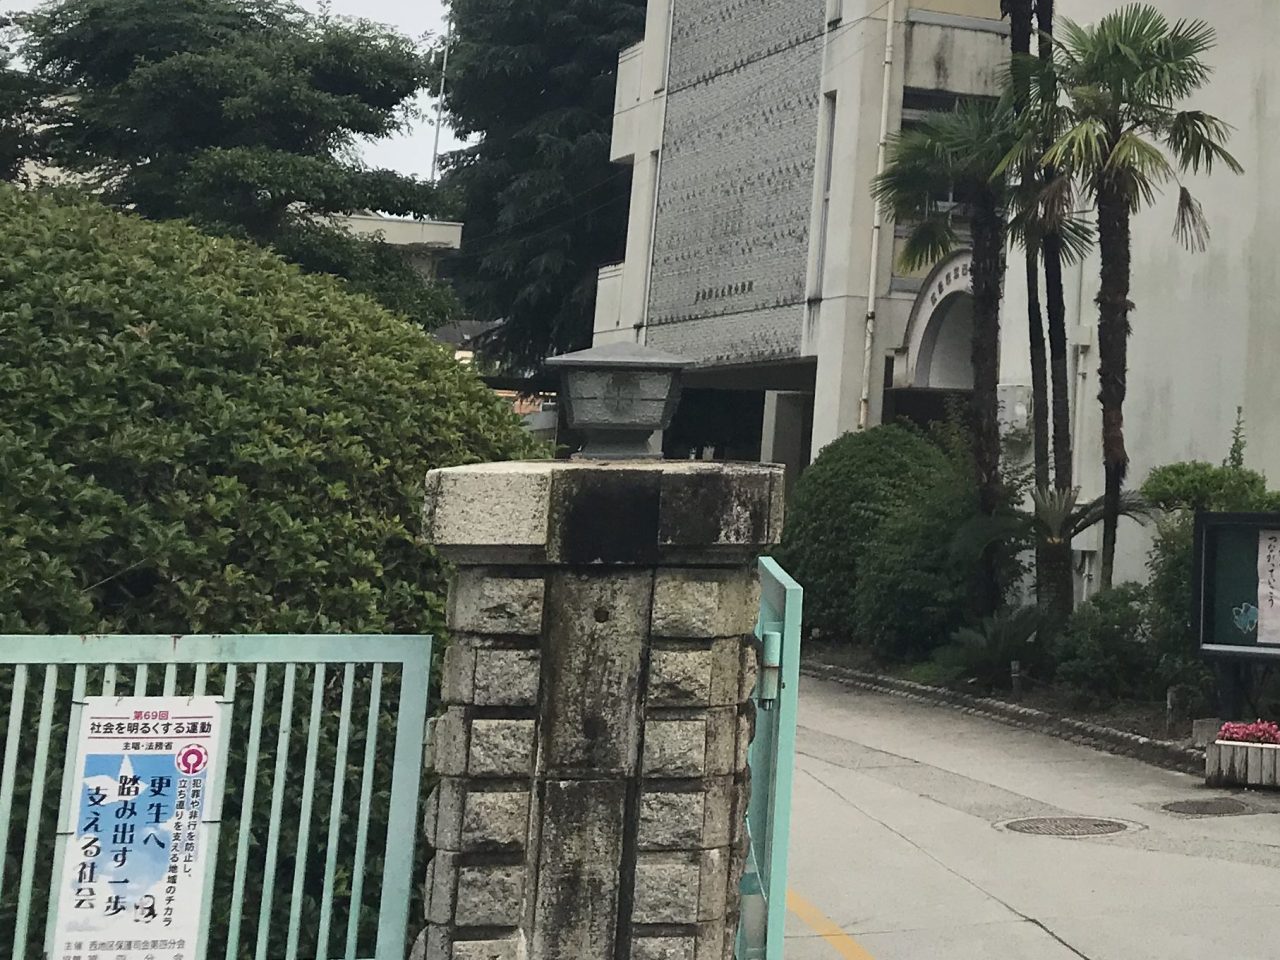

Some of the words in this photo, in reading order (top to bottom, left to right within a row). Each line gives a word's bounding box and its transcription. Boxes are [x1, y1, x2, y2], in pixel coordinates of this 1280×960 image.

[89, 721, 212, 735] 社会を明るくする運動
[132, 710, 169, 721] 第69回
[74, 786, 108, 910] 支える社会
[103, 774, 141, 917] 踏み出す一歩
[142, 775, 172, 850] 更生へ
[162, 778, 188, 928] 立ち直りを支える地域のチカラ
